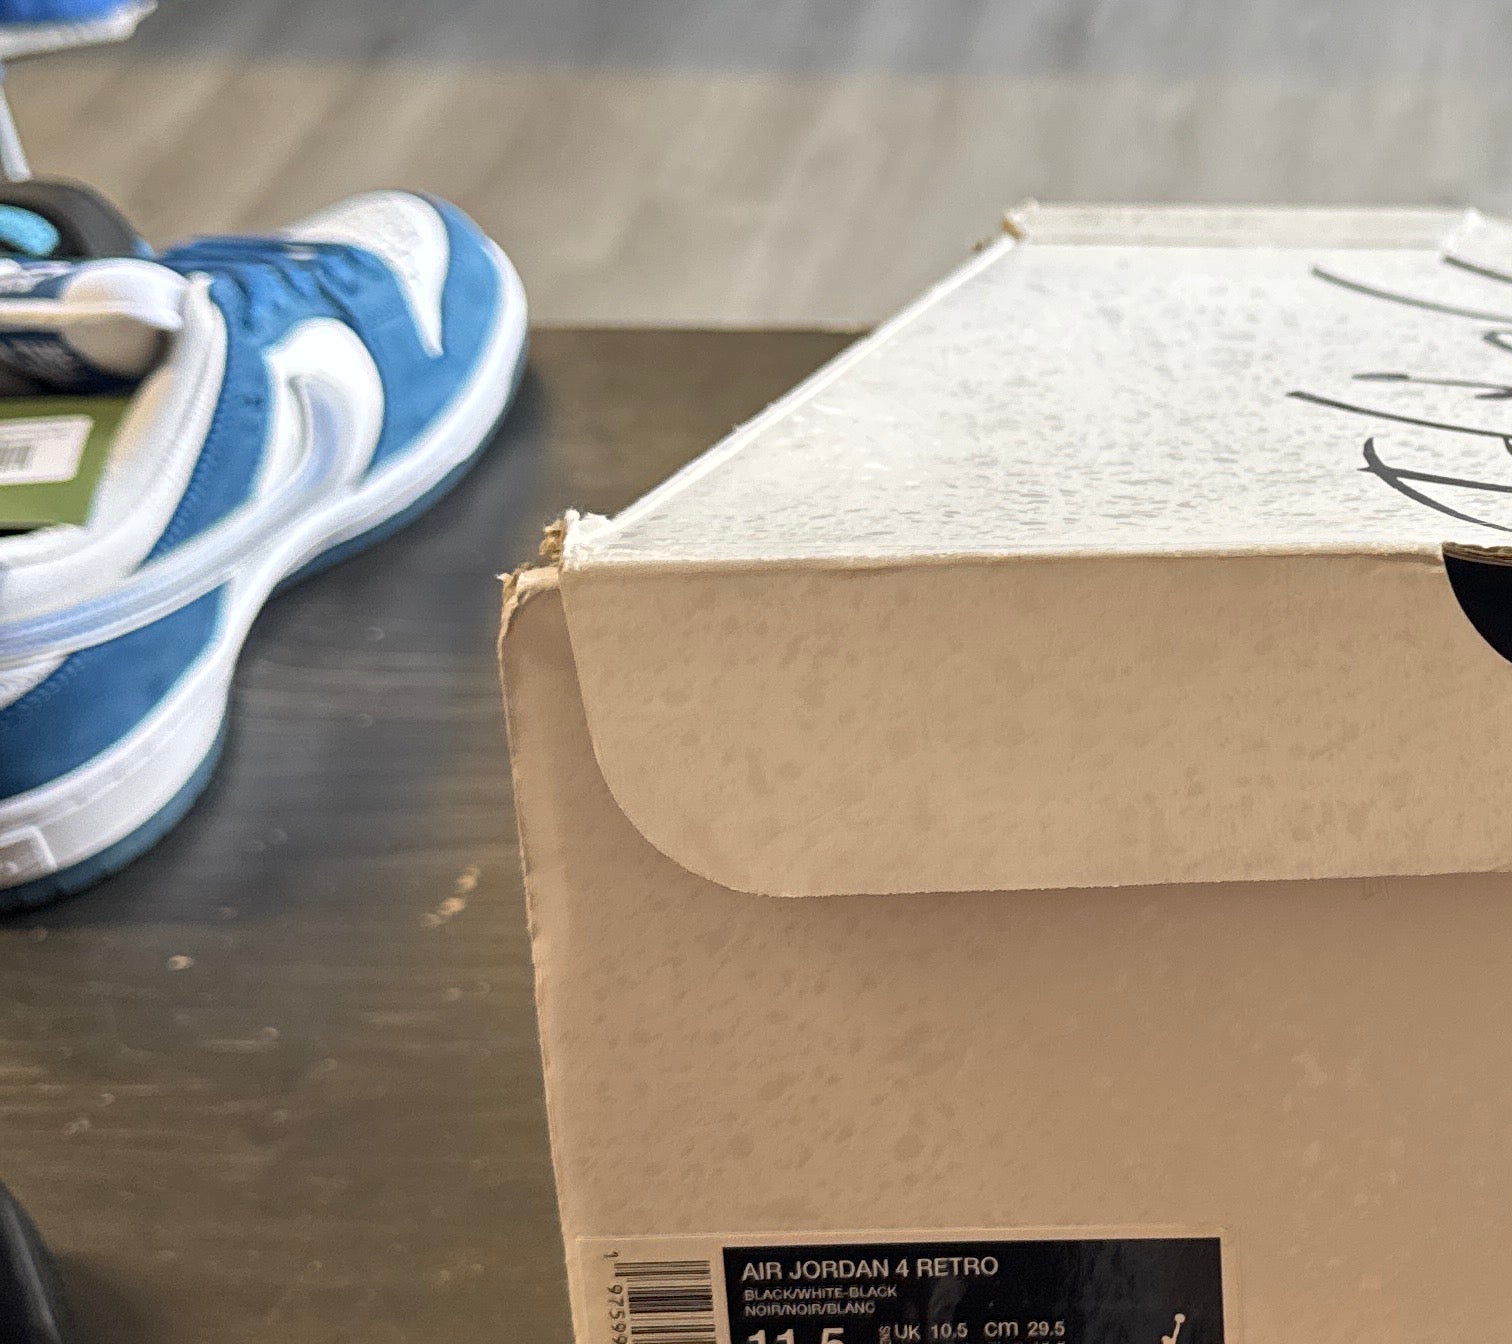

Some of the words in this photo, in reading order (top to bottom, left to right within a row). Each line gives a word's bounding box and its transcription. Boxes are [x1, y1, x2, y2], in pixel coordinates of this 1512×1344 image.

[741, 1261, 783, 1281] AIR
[789, 1258, 889, 1280] JORDAN
[895, 1258, 910, 1278] 4
[917, 1256, 999, 1278] RETRO
[894, 1324, 921, 1340] UK
[930, 1322, 968, 1339] 10.5
[1027, 1321, 1066, 1337] 29.5
